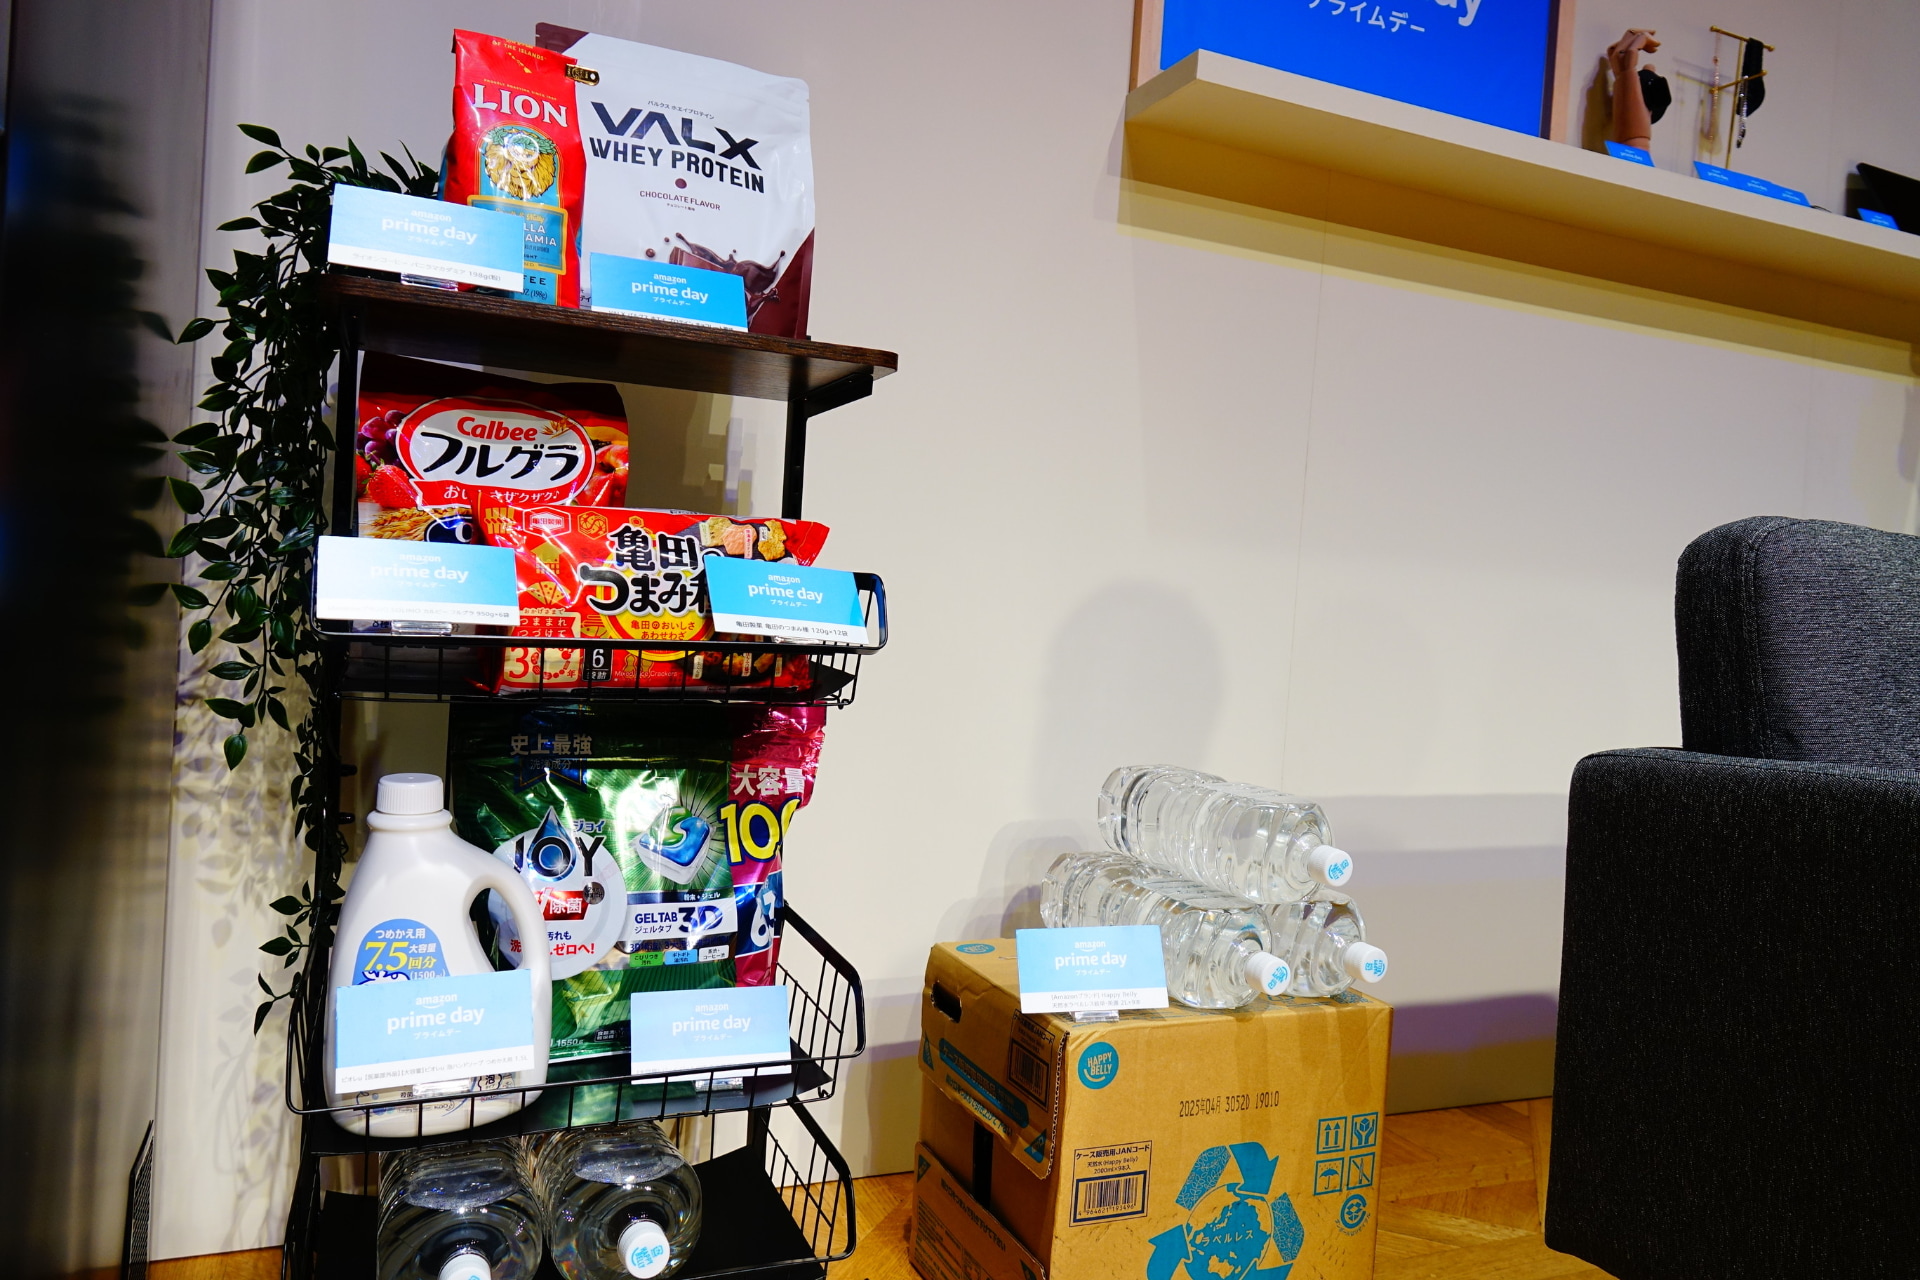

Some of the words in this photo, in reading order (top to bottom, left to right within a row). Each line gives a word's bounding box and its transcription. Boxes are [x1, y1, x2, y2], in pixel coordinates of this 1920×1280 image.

[504, 43, 516, 51] THE
[519, 47, 544, 60] ISLANDS
[472, 82, 568, 127] LION
[591, 101, 762, 171] VALX
[589, 136, 663, 167] WHEY
[671, 150, 765, 194] PROTEIN
[639, 190, 689, 204] CHOCOLATE
[690, 198, 721, 211] FLAVOR
[410, 209, 452, 222] amazon
[382, 216, 440, 237] prime
[443, 223, 478, 246] day
[653, 273, 687, 284] amazon
[631, 281, 679, 297] prime
[681, 287, 709, 304] day
[456, 416, 538, 441] Calbee
[420, 432, 579, 481] フルグラ
[400, 553, 442, 563] amazon
[371, 564, 432, 579] prime
[434, 566, 469, 584] day
[768, 574, 801, 584] amazon
[748, 583, 794, 598] prime
[797, 587, 823, 604] day
[520, 617, 567, 627] つままれ
[631, 620, 695, 630] 亀田のおいしさ
[736, 621, 763, 629] 亀田製菓
[765, 623, 809, 633] 亀田のつまみ種
[519, 629, 567, 638] つづけて
[641, 631, 687, 640] あわせわざ
[650, 670, 678, 678] Crackers
[510, 733, 592, 756] 史上最強
[734, 764, 805, 796] 大容量
[573, 820, 605, 832] ジョイ
[678, 905, 723, 933] 3D
[375, 928, 426, 940] つめかえ用
[634, 924, 672, 935] ジェルタブ
[408, 943, 437, 954] 大容量
[1074, 940, 1106, 949] amazon
[364, 941, 410, 971] 7.5
[408, 956, 437, 970] 回分
[1055, 952, 1098, 970] prime
[1101, 951, 1127, 968] day
[416, 993, 458, 1005] amazon
[695, 1003, 729, 1013] amazon
[387, 1010, 446, 1035] prime
[450, 1006, 485, 1025] day
[672, 1016, 720, 1036] prime
[723, 1015, 751, 1032] day
[1087, 1052, 1112, 1067] HAPPY
[1090, 1064, 1112, 1076] BELLY
[1179, 1096, 1221, 1117] 2025年04月
[1256, 1091, 1280, 1109] 19010
[1076, 1144, 1150, 1160] ケース販売用JANコード
[1201, 1230, 1254, 1247] ラベルレス
